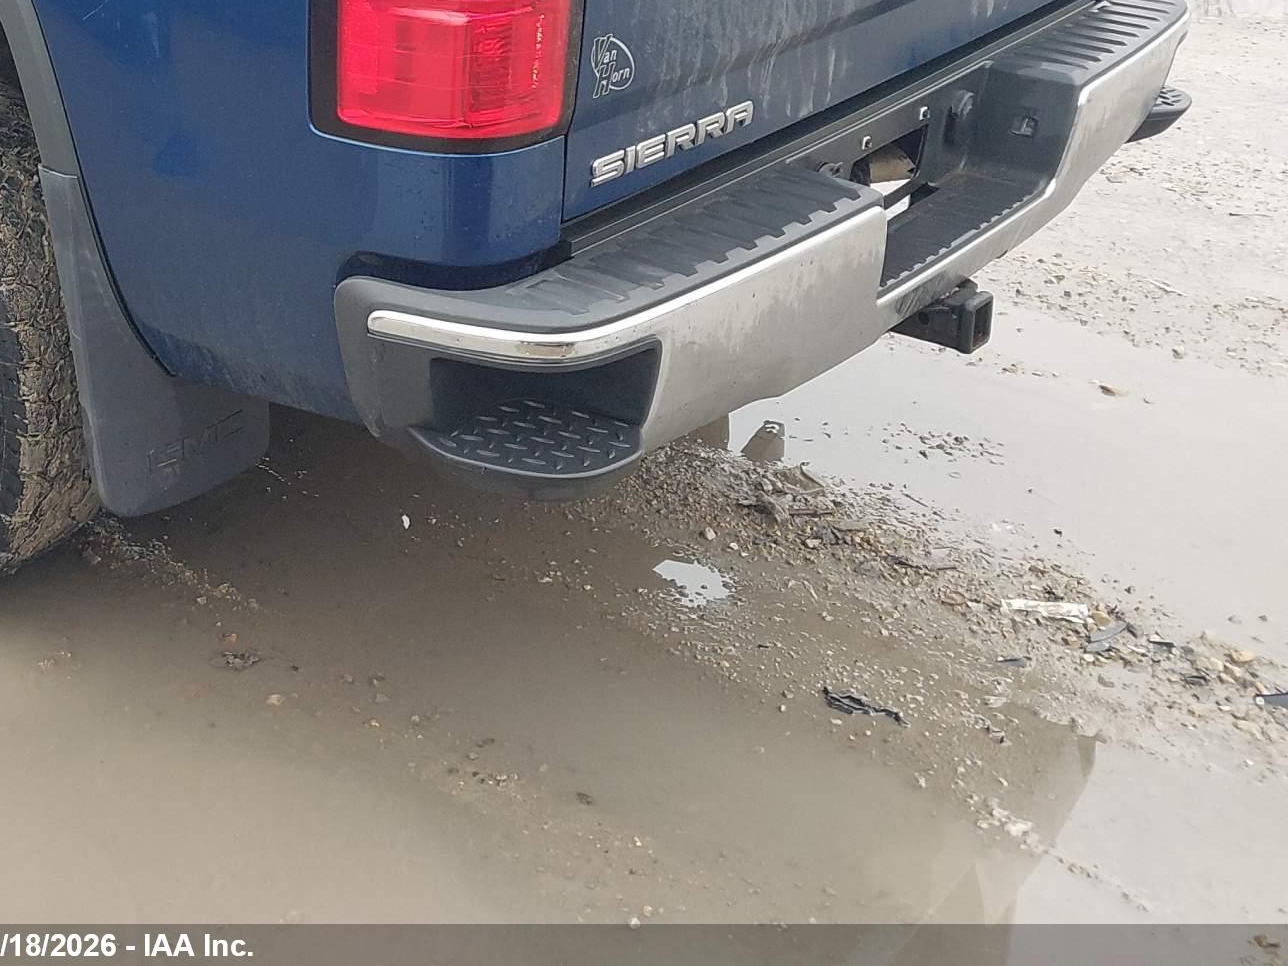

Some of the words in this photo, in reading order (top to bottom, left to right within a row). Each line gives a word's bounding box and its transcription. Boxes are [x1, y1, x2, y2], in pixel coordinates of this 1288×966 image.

[592, 33, 617, 72] Van
[592, 61, 630, 99] Horn
[590, 100, 754, 187] SIERRA
